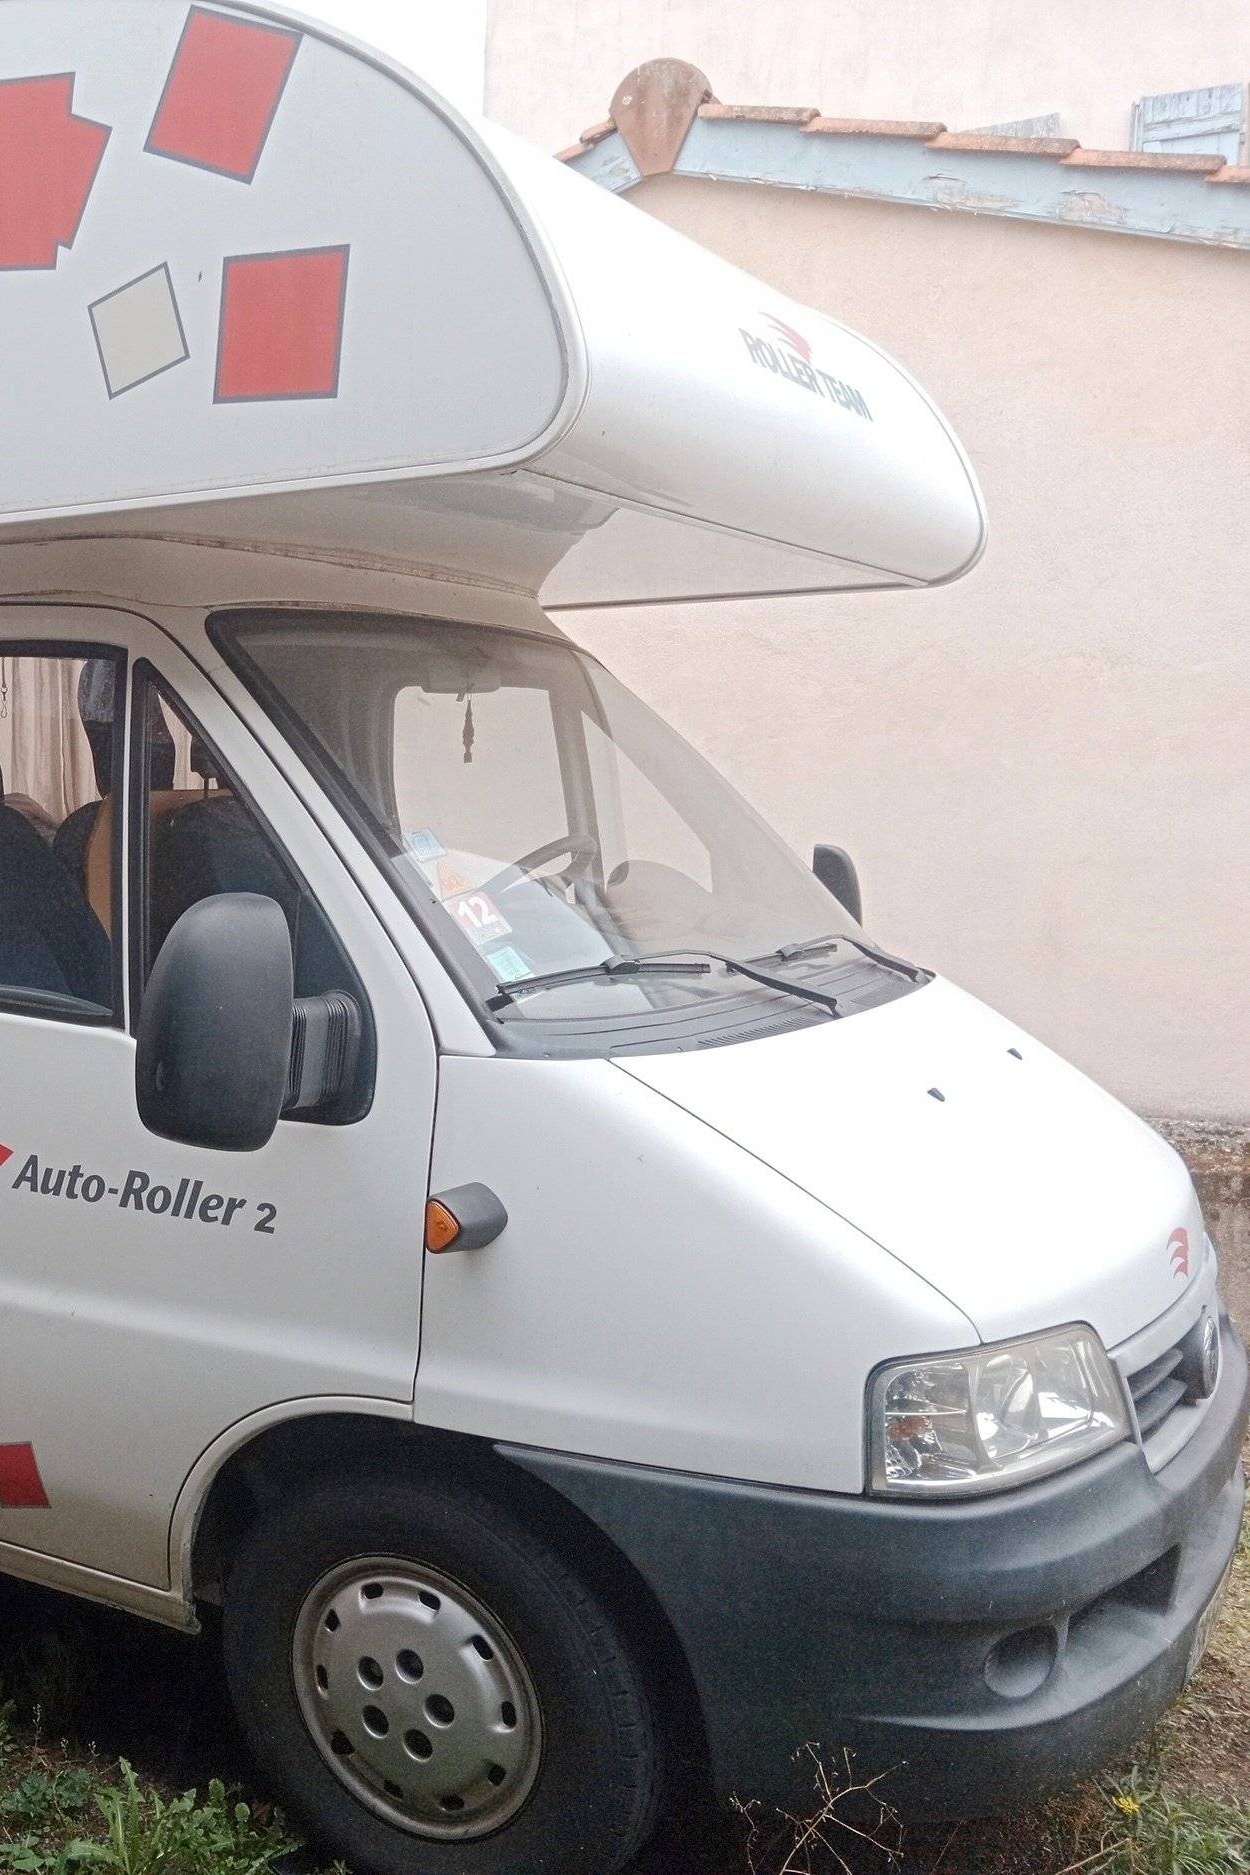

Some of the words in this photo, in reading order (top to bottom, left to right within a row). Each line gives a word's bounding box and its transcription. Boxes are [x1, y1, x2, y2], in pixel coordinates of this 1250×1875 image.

[738, 327, 825, 398] ROLLER
[815, 368, 874, 422] TEAM
[457, 896, 499, 928] 12
[12, 1154, 247, 1226] Auto-Roller
[254, 1203, 277, 1234] 2
